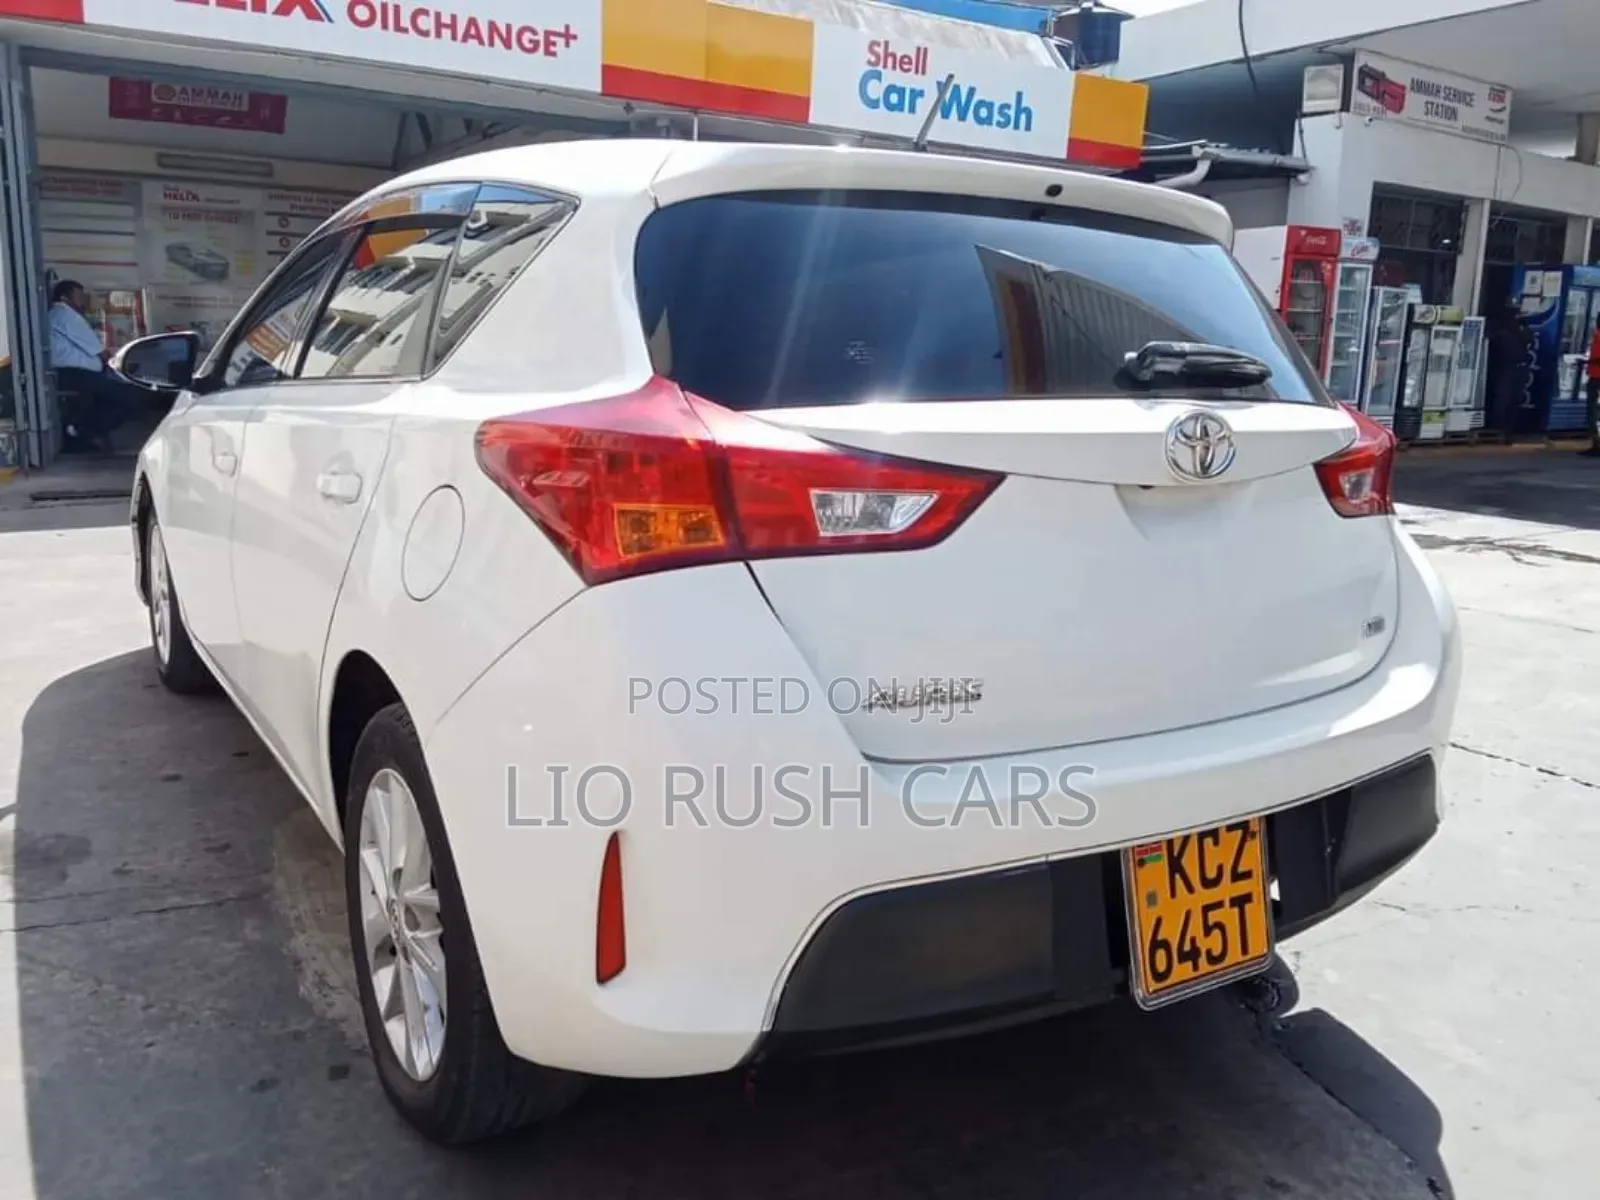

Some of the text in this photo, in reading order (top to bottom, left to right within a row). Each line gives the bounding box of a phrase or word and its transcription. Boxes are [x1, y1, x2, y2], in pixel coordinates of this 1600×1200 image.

[866, 39, 929, 76] Shell
[858, 69, 1034, 132] Car Wash
[1410, 77, 1441, 97] AMMAH
[1442, 84, 1476, 108] SERVICE
[1424, 101, 1458, 121] STATION
[1166, 820, 1254, 899] KCZ
[1148, 892, 1254, 983] 645T
